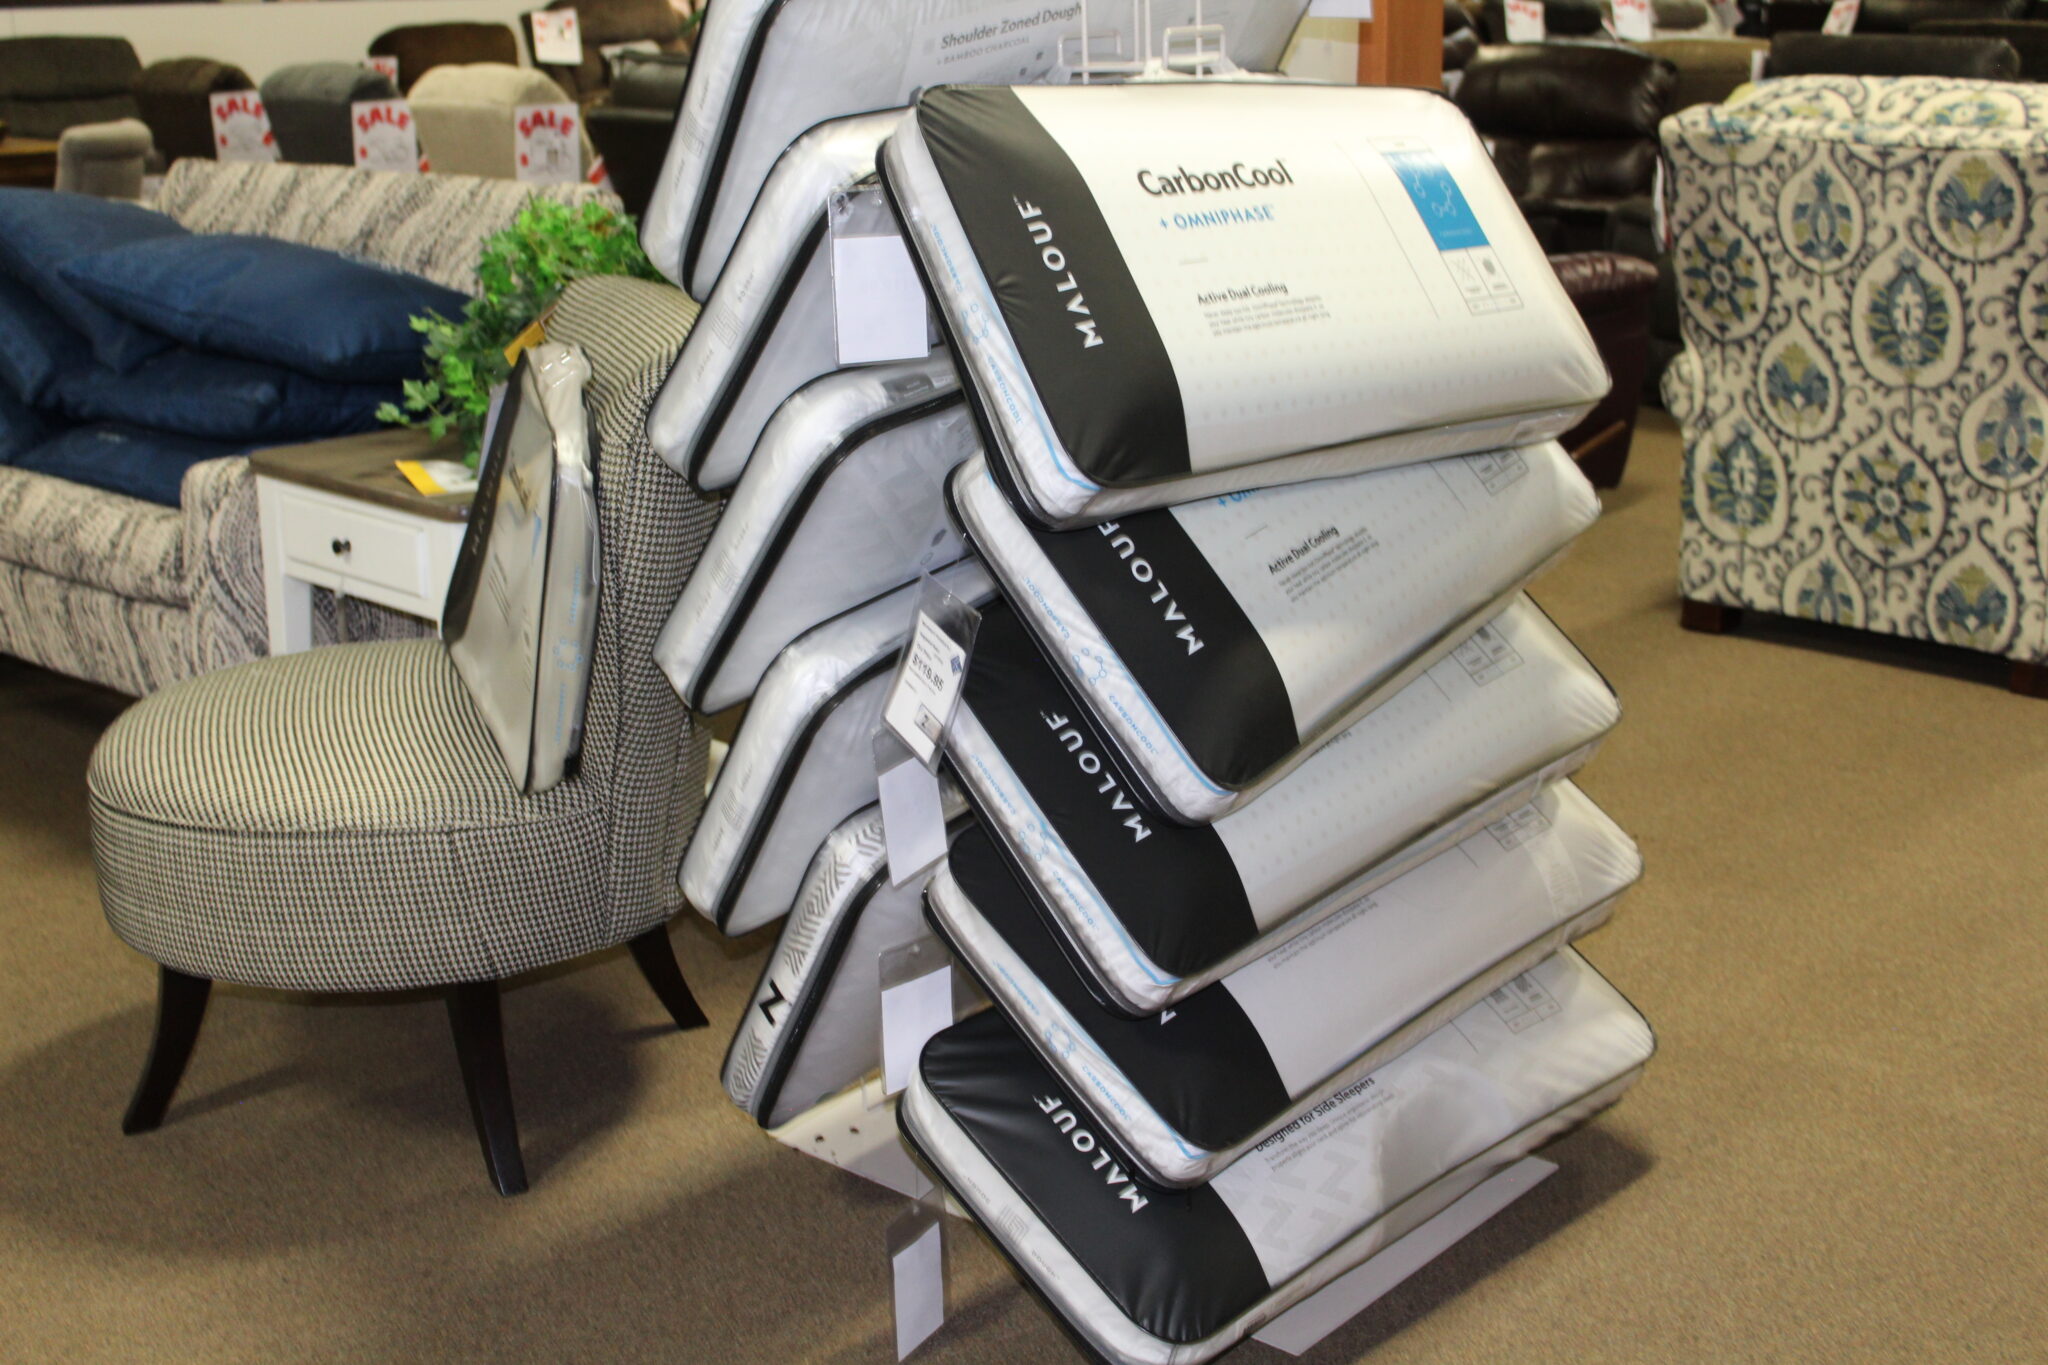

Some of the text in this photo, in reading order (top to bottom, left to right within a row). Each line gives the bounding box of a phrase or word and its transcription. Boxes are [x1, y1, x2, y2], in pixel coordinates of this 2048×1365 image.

[941, 2, 1082, 49] Shoulder Zoned Dough
[216, 97, 264, 121] SALE
[357, 106, 410, 133] SALE
[518, 109, 574, 138] SALE
[1137, 159, 1294, 198] CarbonCool
[1173, 205, 1274, 230] OMNIPHASE
[1015, 198, 1104, 349] MALOUF
[1197, 281, 1289, 306] Active Dual Cooling
[1268, 526, 1341, 575] Active Dual Cooling
[1098, 519, 1205, 656] MALOUF
[1043, 710, 1153, 843] MALOUF
[1255, 1076, 1376, 1153] Designed for Side Sleepers
[1037, 1094, 1149, 1214] MALOUF
